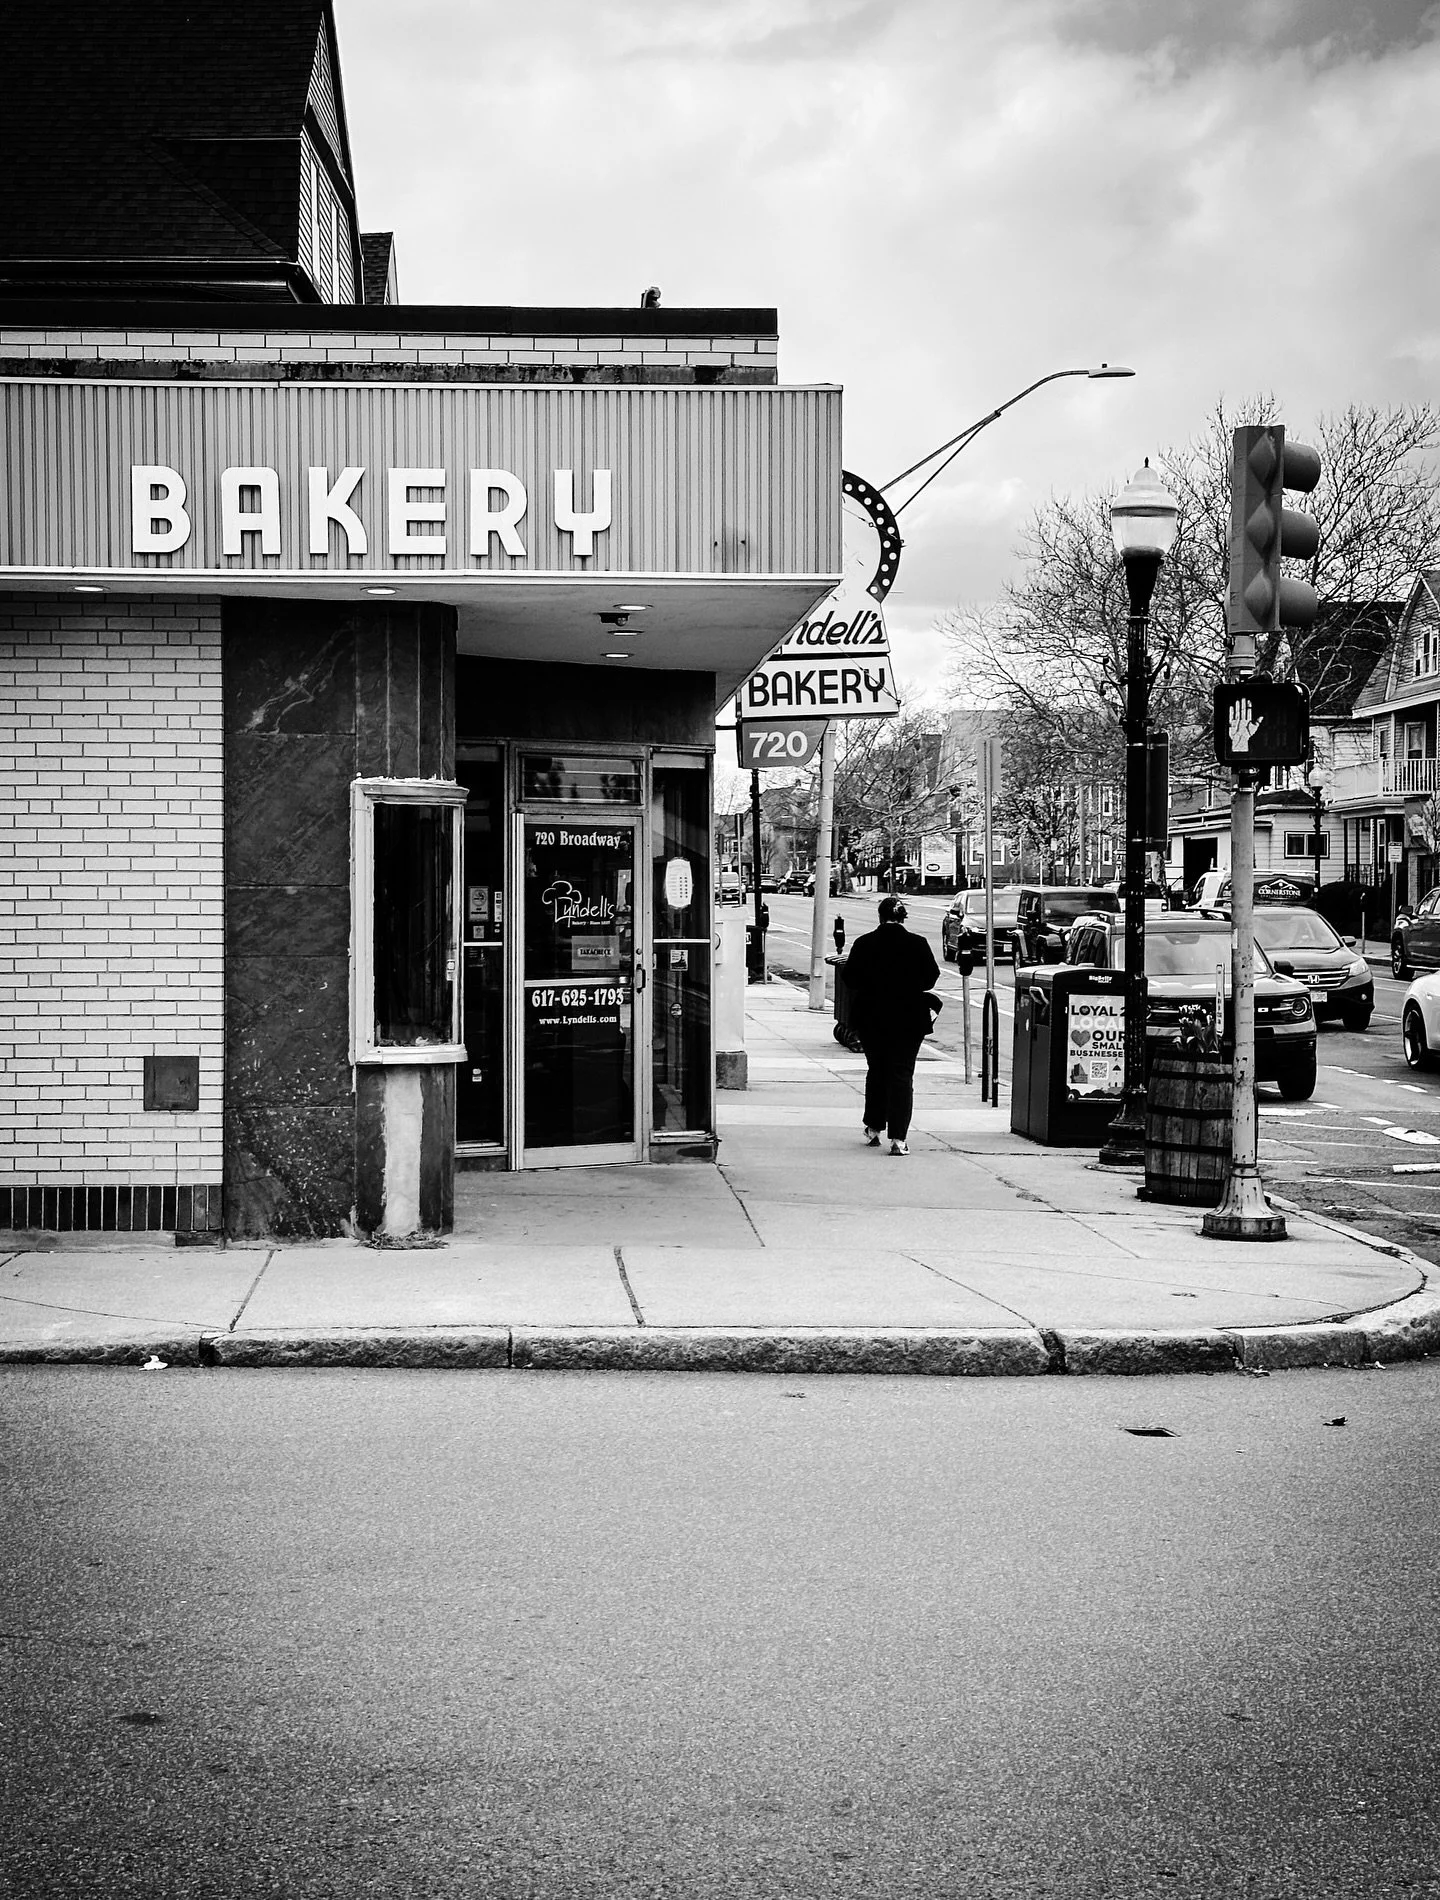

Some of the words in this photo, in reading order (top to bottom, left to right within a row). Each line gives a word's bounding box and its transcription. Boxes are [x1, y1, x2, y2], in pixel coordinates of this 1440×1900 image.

[131, 465, 612, 556] BAKERY
[783, 610, 887, 646] ndell's
[748, 668, 885, 708] BAKERY
[749, 730, 808, 758] 720
[535, 831, 556, 846] 720
[559, 830, 621, 850] Broadway
[1257, 888, 1301, 897] CORNERSTONE
[554, 896, 615, 928] Lyndell's
[531, 988, 624, 1007] 617-625-1793
[539, 1015, 617, 1025] www.Lyndells.com
[1071, 1005, 1118, 1017] LOYAL
[1070, 1050, 1124, 1058] BUSINESSE
[1092, 1042, 1124, 1050] SMAL
